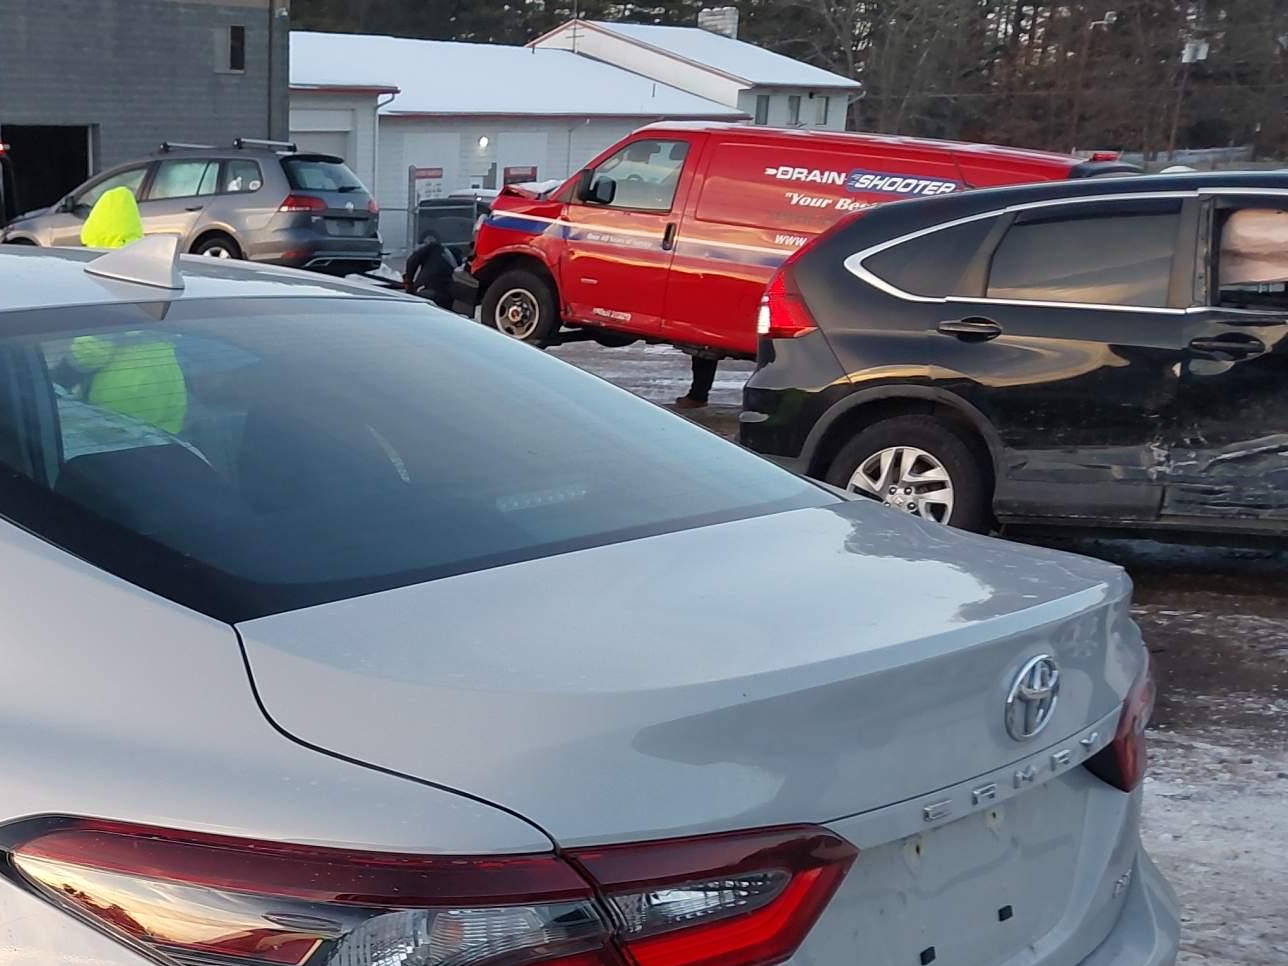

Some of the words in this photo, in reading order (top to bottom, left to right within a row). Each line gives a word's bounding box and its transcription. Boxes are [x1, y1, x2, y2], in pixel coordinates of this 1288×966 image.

[776, 166, 847, 185] DRAIN
[854, 174, 957, 195] SHOOTER
[923, 732, 1099, 822] CAMRY
